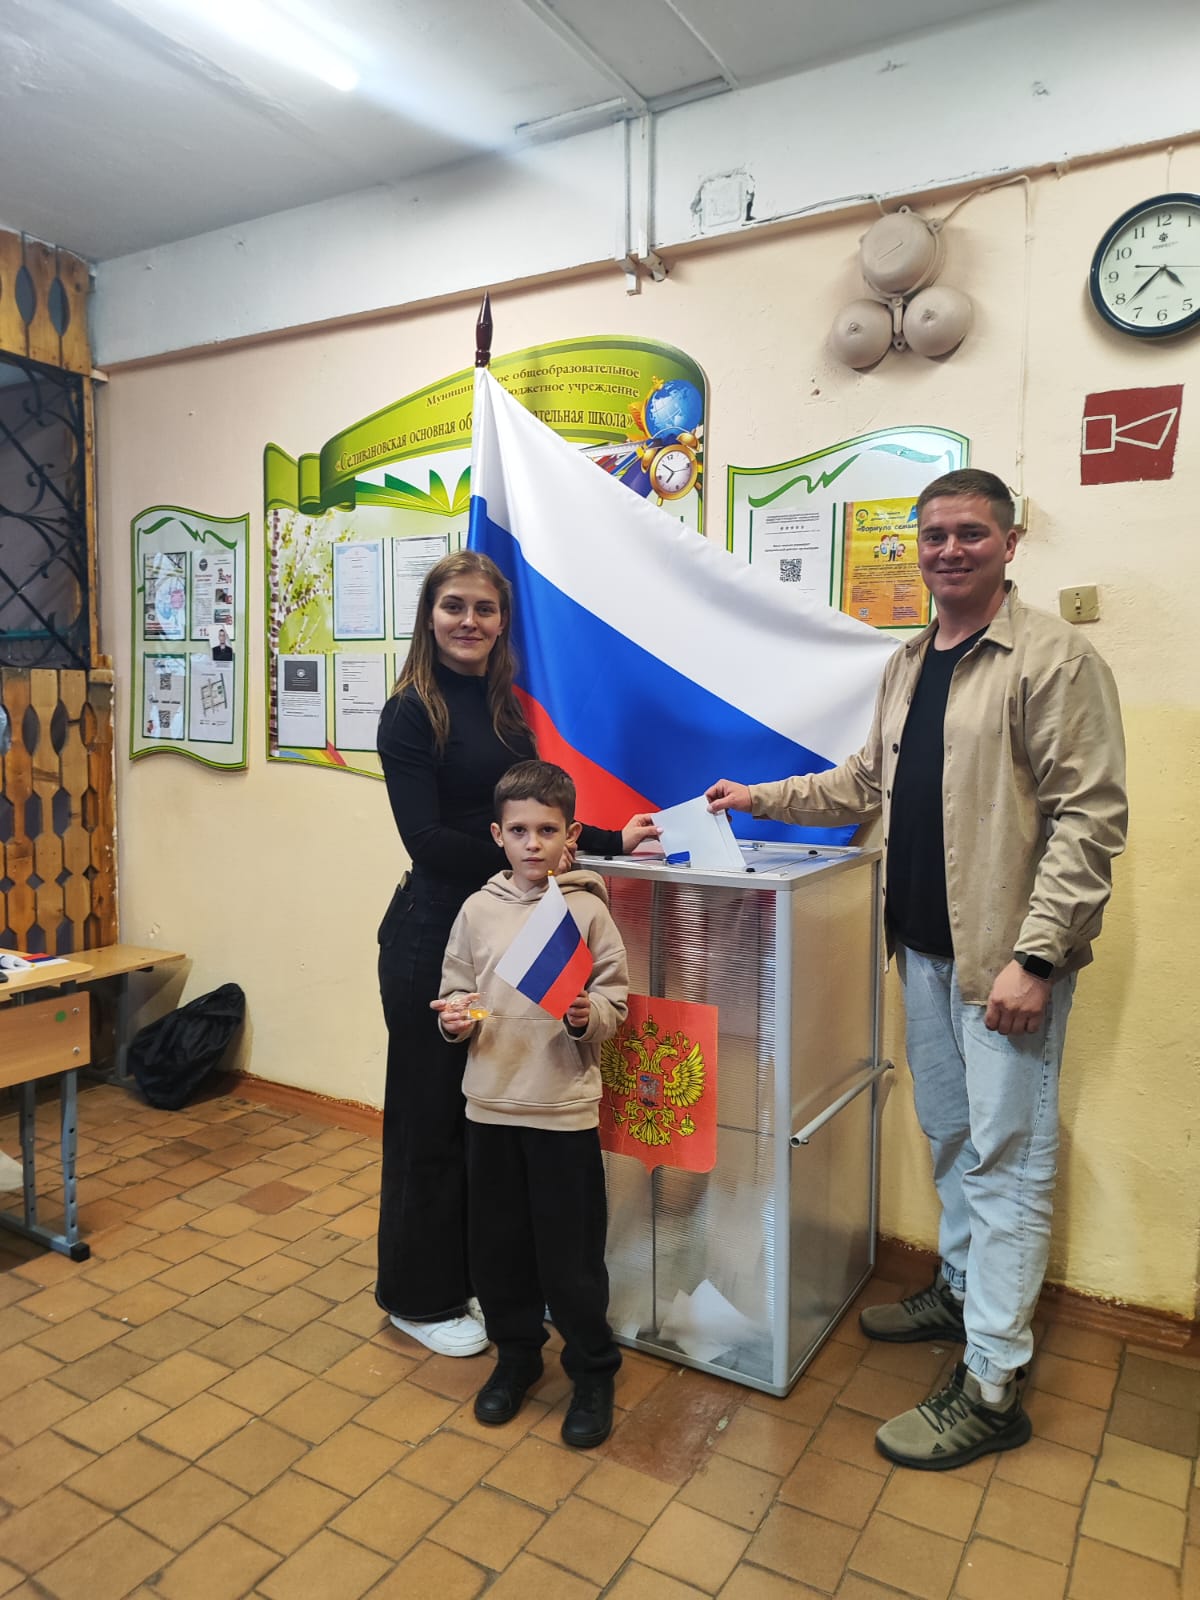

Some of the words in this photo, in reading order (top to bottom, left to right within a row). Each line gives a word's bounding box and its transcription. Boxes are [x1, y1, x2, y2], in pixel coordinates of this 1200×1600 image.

[1157, 213, 1172, 227] 12
[1187, 215, 1192, 227] 1
[1133, 226, 1145, 239] 11
[1116, 247, 1132, 261] 10
[1108, 271, 1119, 284] 9
[1115, 293, 1126, 305] 8
[1182, 298, 1193, 311] 5
[1133, 306, 1143, 320] 7
[1157, 309, 1168, 322] 6
[512, 363, 640, 379] общеобразовательное
[504, 382, 564, 396] юджетное
[568, 382, 640, 398] учреждение
[409, 420, 456, 443] основная
[588, 410, 633, 429] школа»
